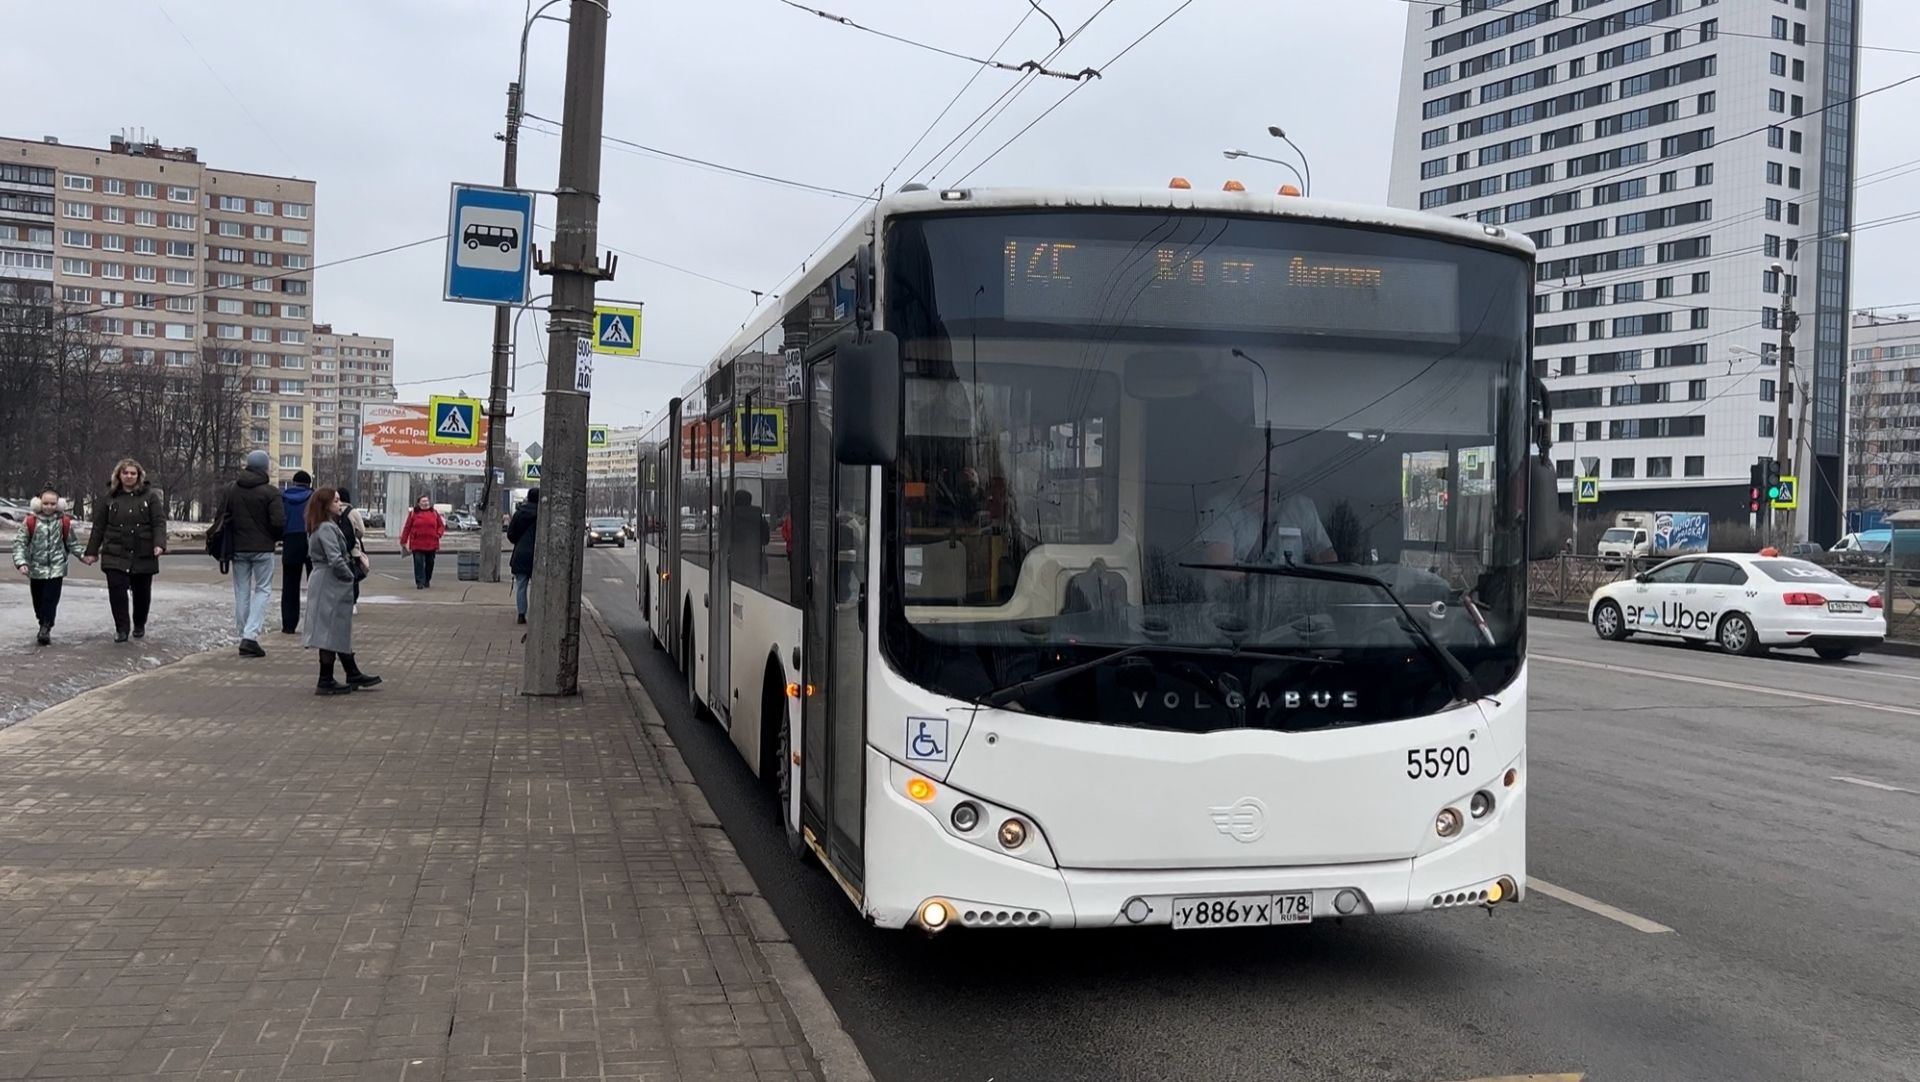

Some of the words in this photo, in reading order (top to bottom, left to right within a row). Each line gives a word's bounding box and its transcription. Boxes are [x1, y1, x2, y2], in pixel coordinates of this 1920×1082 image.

[1662, 601, 1718, 630] Uber
[1407, 746, 1470, 780] 5590
[1274, 896, 1306, 914] 178
